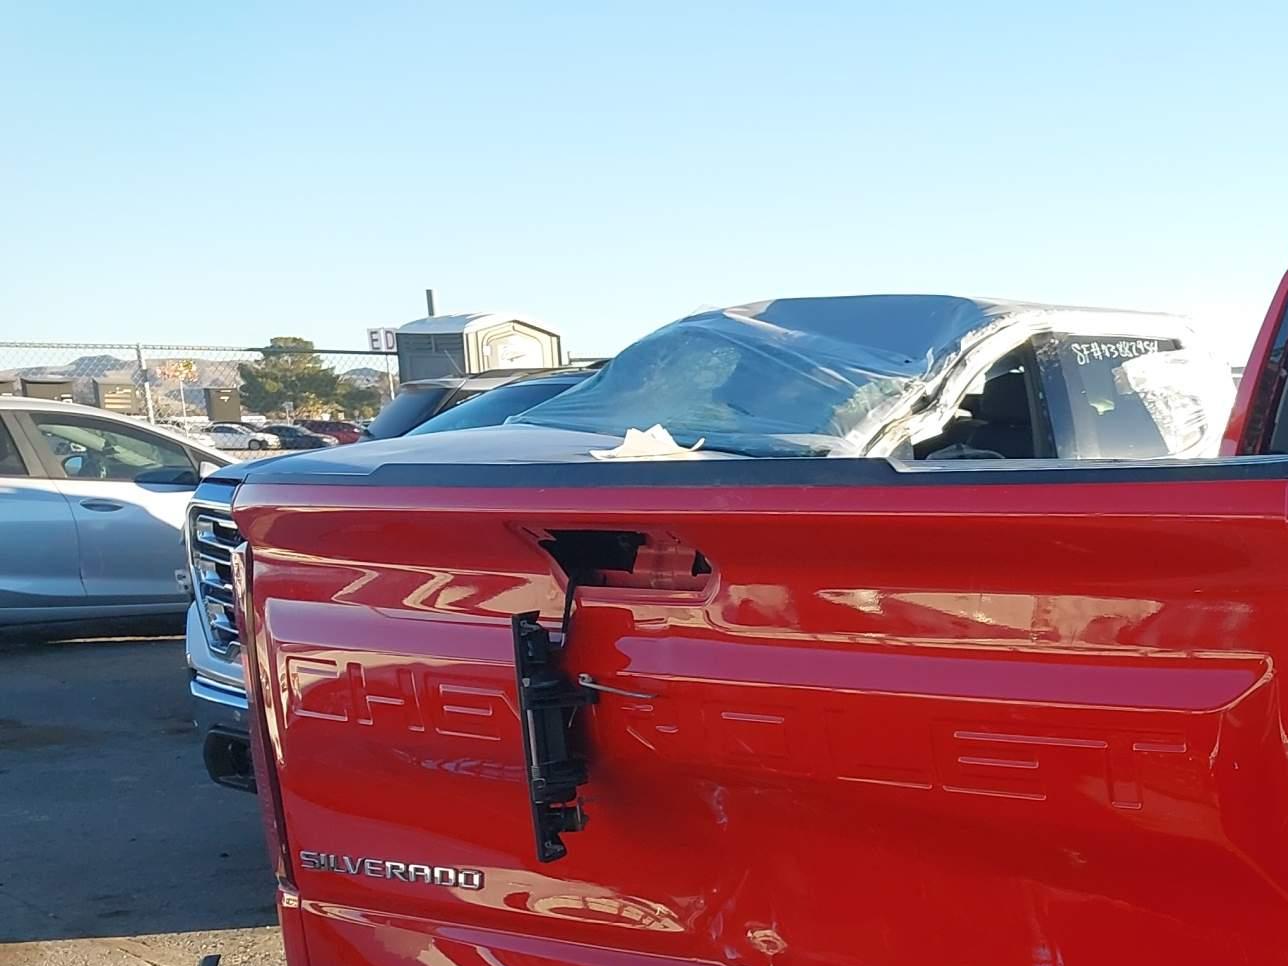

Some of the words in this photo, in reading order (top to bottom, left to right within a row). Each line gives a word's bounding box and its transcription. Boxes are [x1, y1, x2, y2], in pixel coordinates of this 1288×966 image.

[370, 331, 381, 350] E
[385, 331, 395, 350] D
[299, 850, 485, 891] SILVERADO
